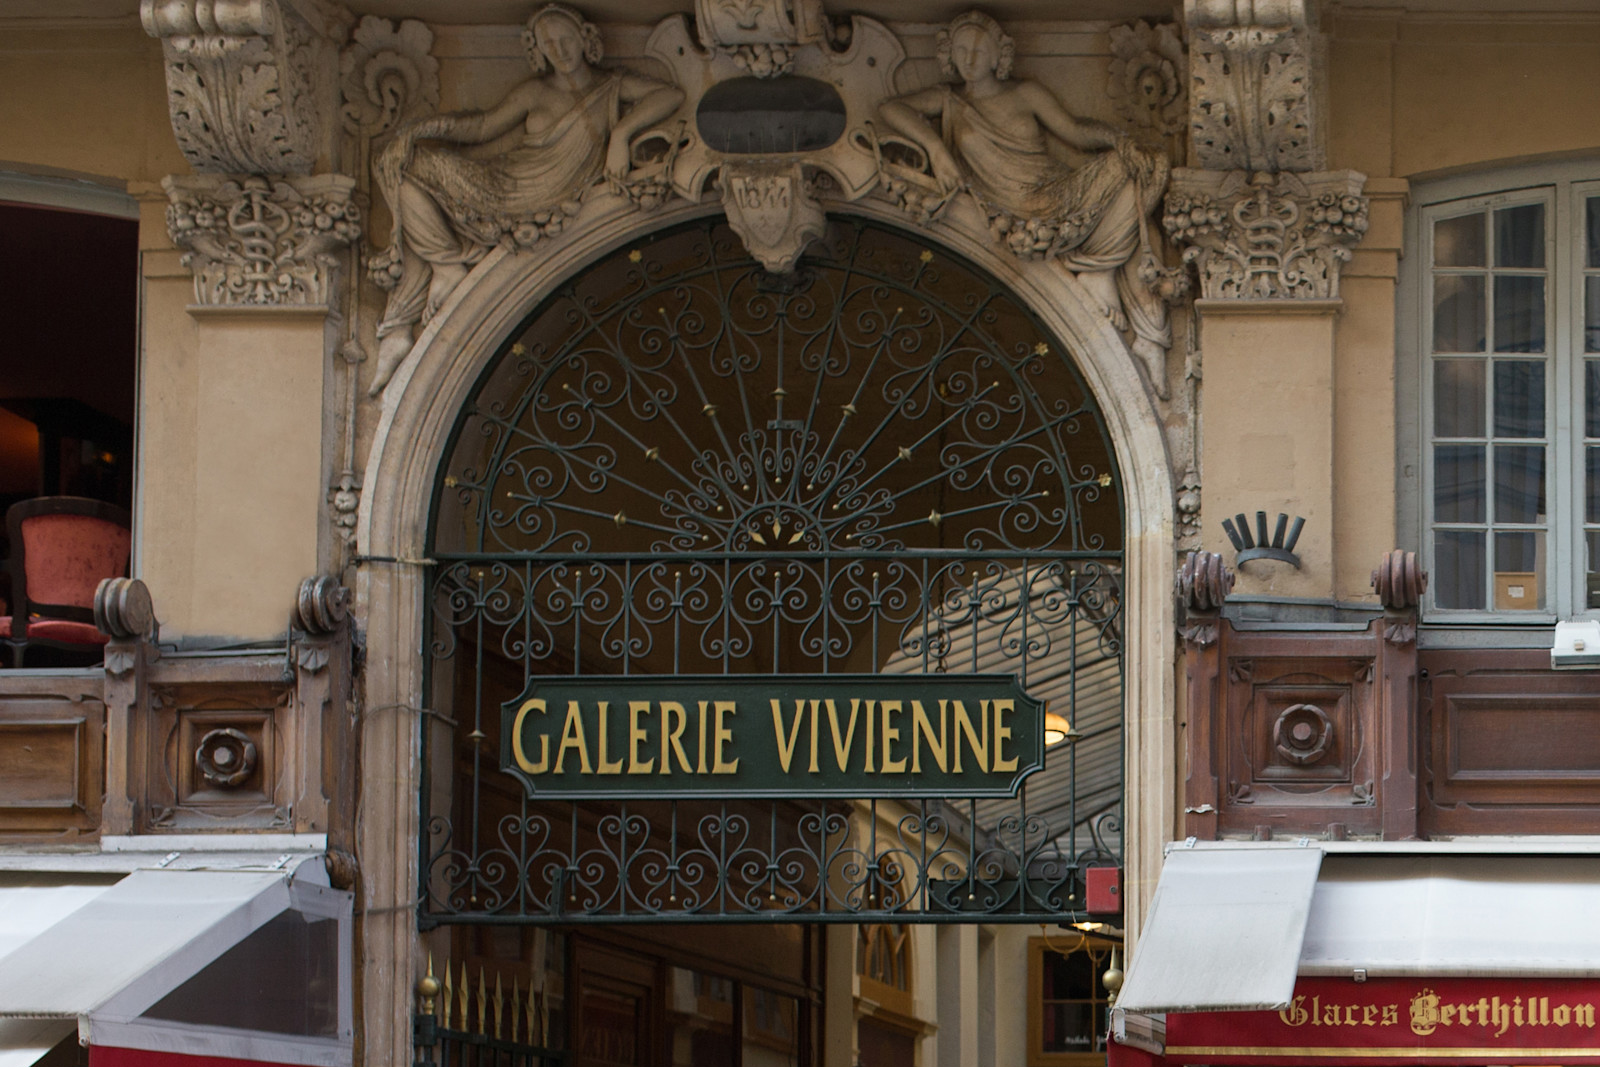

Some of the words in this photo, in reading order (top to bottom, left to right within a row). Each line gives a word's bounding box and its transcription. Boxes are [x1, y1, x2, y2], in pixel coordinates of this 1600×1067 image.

[512, 699, 739, 775] GALERIE
[769, 698, 1020, 774] VIVIENNE
[1279, 994, 1398, 1028] Glaces
[1410, 988, 1595, 1038] Berthillon
